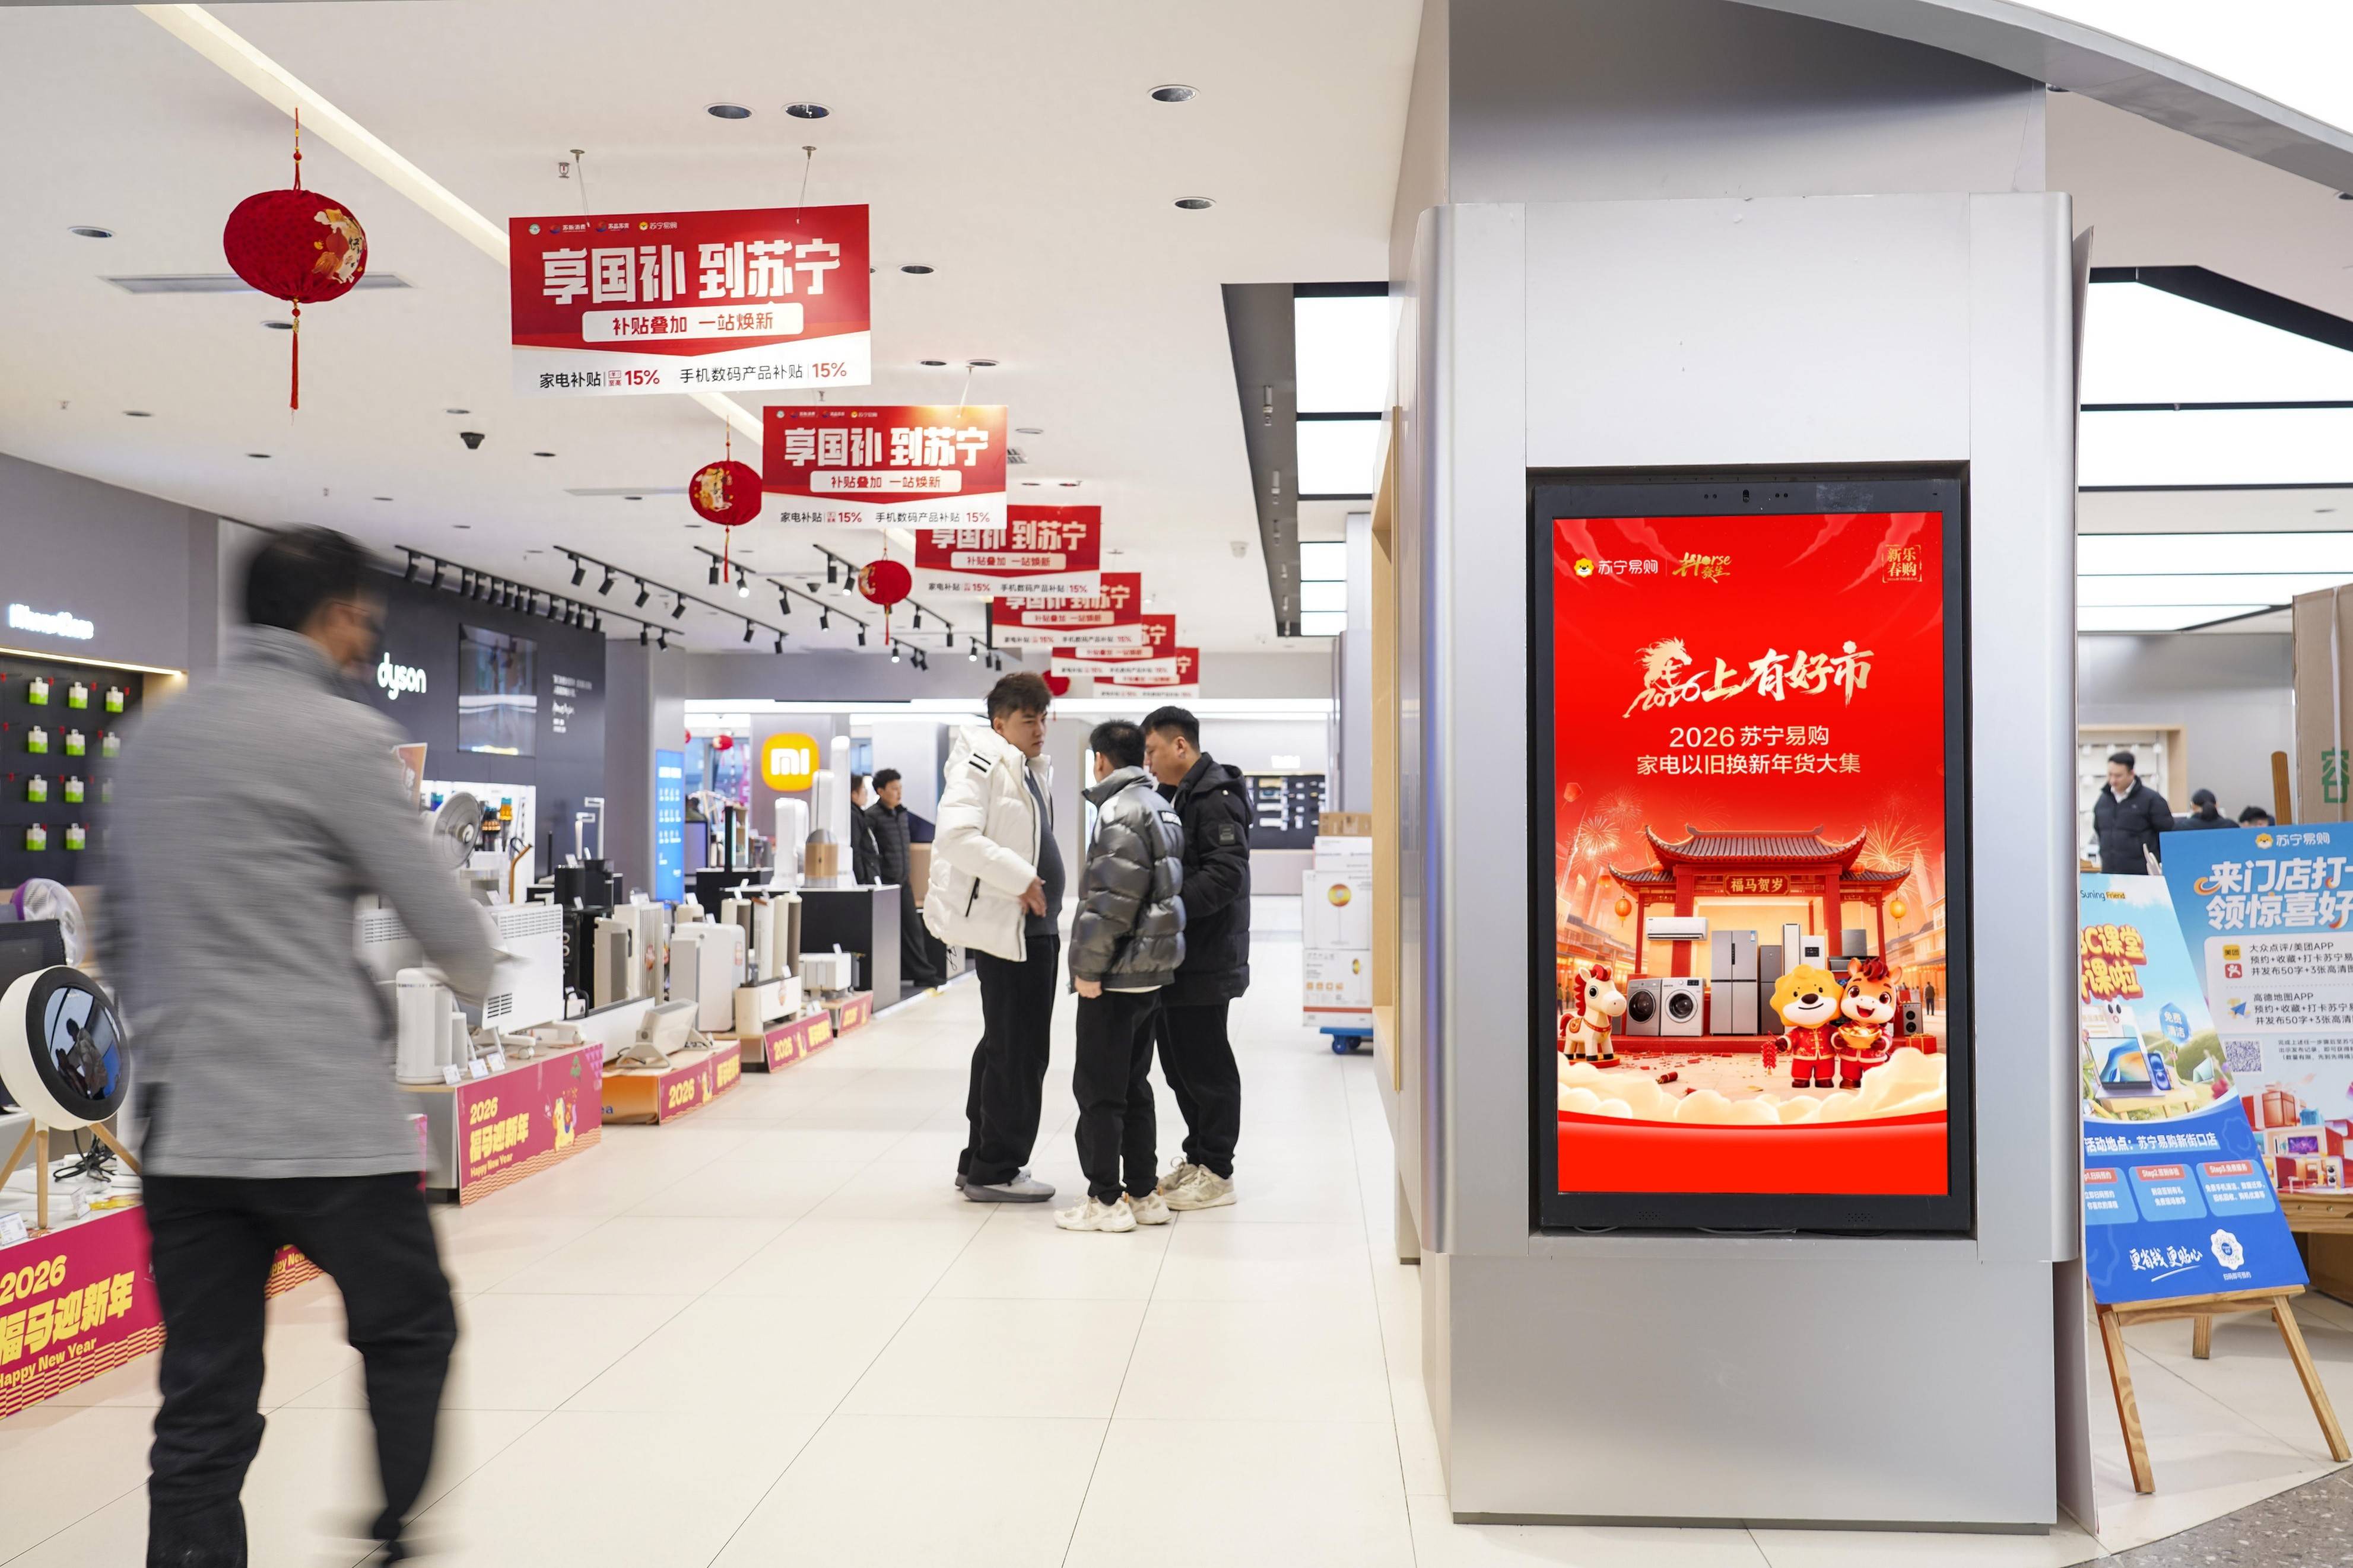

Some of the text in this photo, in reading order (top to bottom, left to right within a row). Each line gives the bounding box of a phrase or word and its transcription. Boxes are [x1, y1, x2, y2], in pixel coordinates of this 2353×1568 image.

[649, 222, 678, 230] 苏宁易购
[542, 238, 841, 305] 享国补 到苏宁
[612, 312, 774, 336] 补贴叠加 一站焕新
[540, 372, 601, 389] 家电补贴
[625, 370, 660, 386] 15%
[680, 362, 847, 383] 手机数码产品补贴 15%
[785, 427, 989, 466] 享国补 到苏宁
[831, 476, 941, 488] 补贴叠加 一站焕新
[780, 512, 823, 523] 家电补贴
[839, 513, 862, 523] 15%
[875, 512, 990, 523] 手机数码产品补贴 15%
[1011, 520, 1087, 551] 到苏宁
[1598, 559, 1659, 575] 苏宁易购
[1069, 584, 1088, 593] 15%
[377, 652, 427, 701] dyson
[1669, 726, 1830, 748] 2026 苏宁易购
[1636, 753, 1862, 775] 家电以旧换新年货大集
[2322, 747, 2349, 803] 容
[2276, 832, 2330, 847] 苏宁易购
[1729, 877, 1784, 893] 福马贺岁
[2194, 856, 2353, 895] 来门店打
[2080, 890, 2126, 901] Suning Friend
[2206, 890, 2353, 931] 领惊喜好
[2250, 942, 2334, 953] 大众点评/美团APP
[2081, 956, 2141, 997] 课啦
[2253, 993, 2314, 1002] 高德地图APP
[2164, 1011, 2183, 1023] 免费
[2256, 1014, 2353, 1026] 并发布50字+3张高清
[773, 1036, 793, 1062] 2026
[668, 1077, 695, 1109] 2026
[470, 1096, 498, 1126] 2026
[469, 1112, 530, 1164] 福马迎新年
[471, 1153, 513, 1178] Happy New Year
[0, 1255, 68, 1306] 2026
[0, 1270, 135, 1365] 福马迎新年
[38, 1350, 66, 1372] New
[68, 1337, 97, 1359] Year
